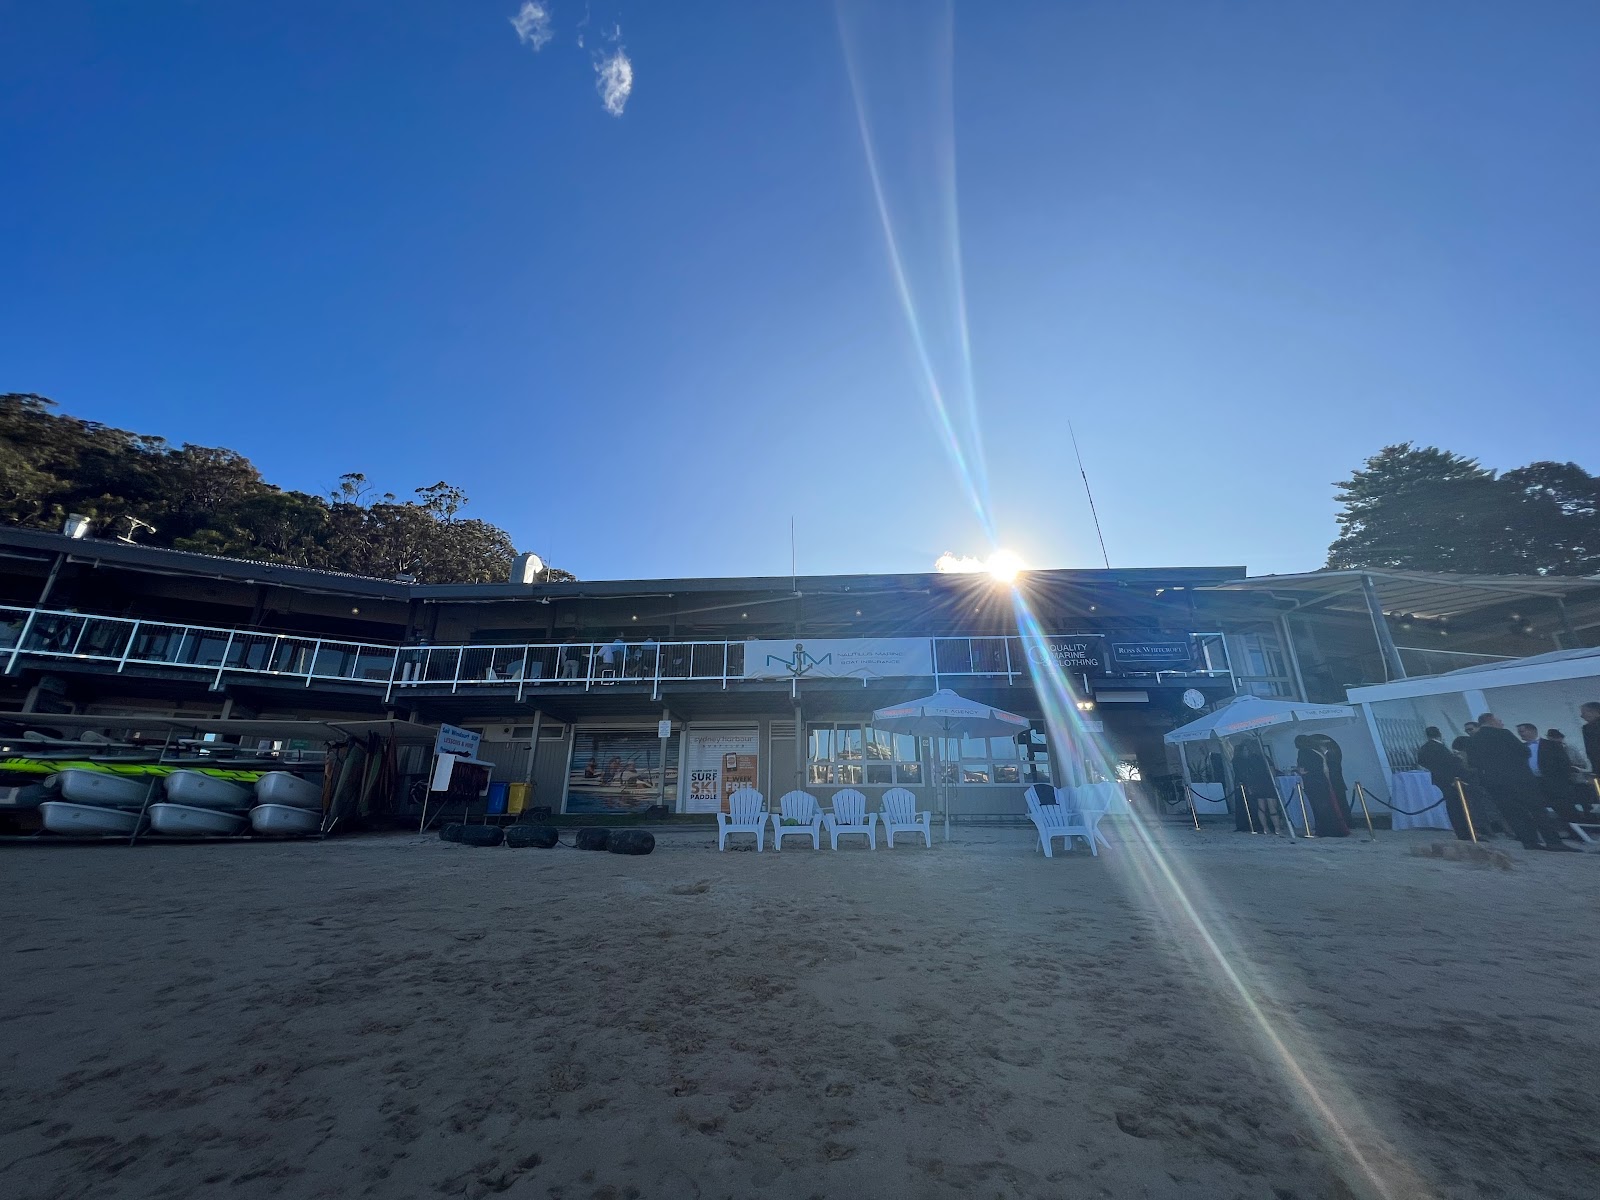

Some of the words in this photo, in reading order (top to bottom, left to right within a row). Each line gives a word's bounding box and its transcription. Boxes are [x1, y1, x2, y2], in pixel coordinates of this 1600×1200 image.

[1050, 643, 1087, 651] QUALITY
[1052, 651, 1085, 659] MARINE
[1052, 658, 1098, 667] CLOTHING
[691, 772, 718, 781] SURF
[691, 781, 717, 794] SKI
[726, 782, 752, 792] FREE
